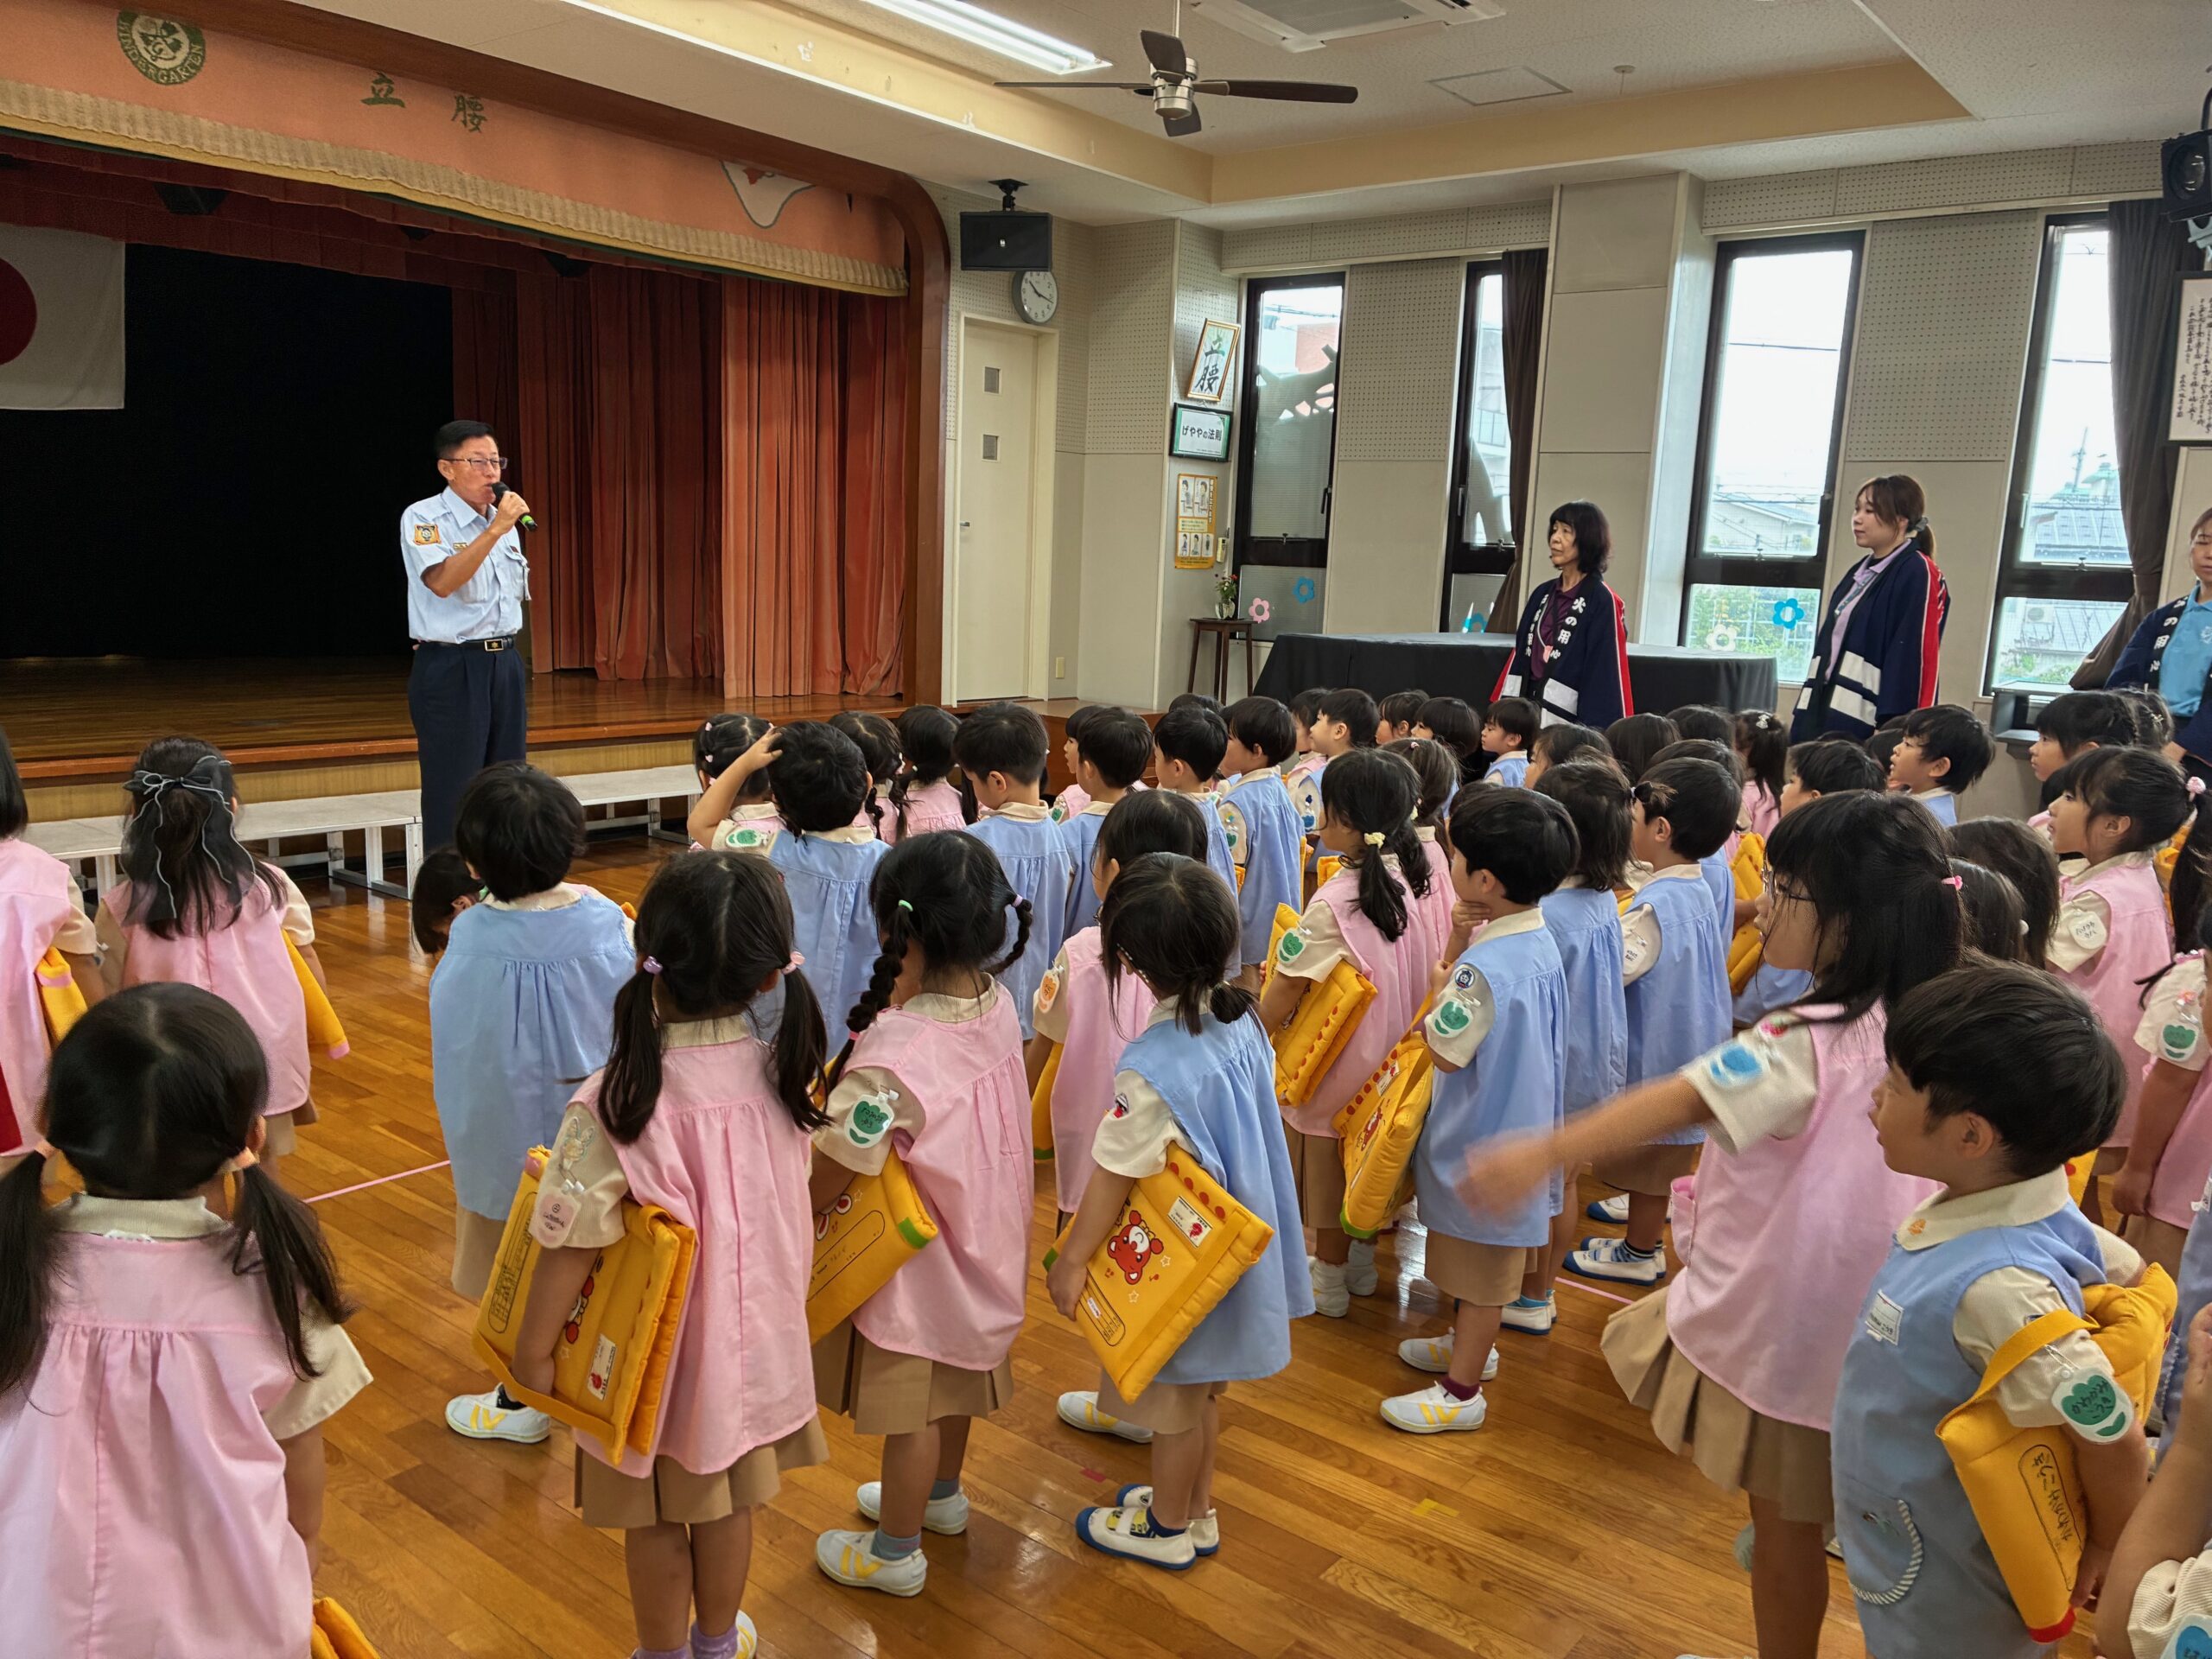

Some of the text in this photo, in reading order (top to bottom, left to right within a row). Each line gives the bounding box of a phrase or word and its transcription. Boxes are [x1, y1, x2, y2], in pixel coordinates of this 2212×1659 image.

[119, 21, 204, 84] KINDERGARTEN
[1549, 597, 1586, 659] 火の用心
